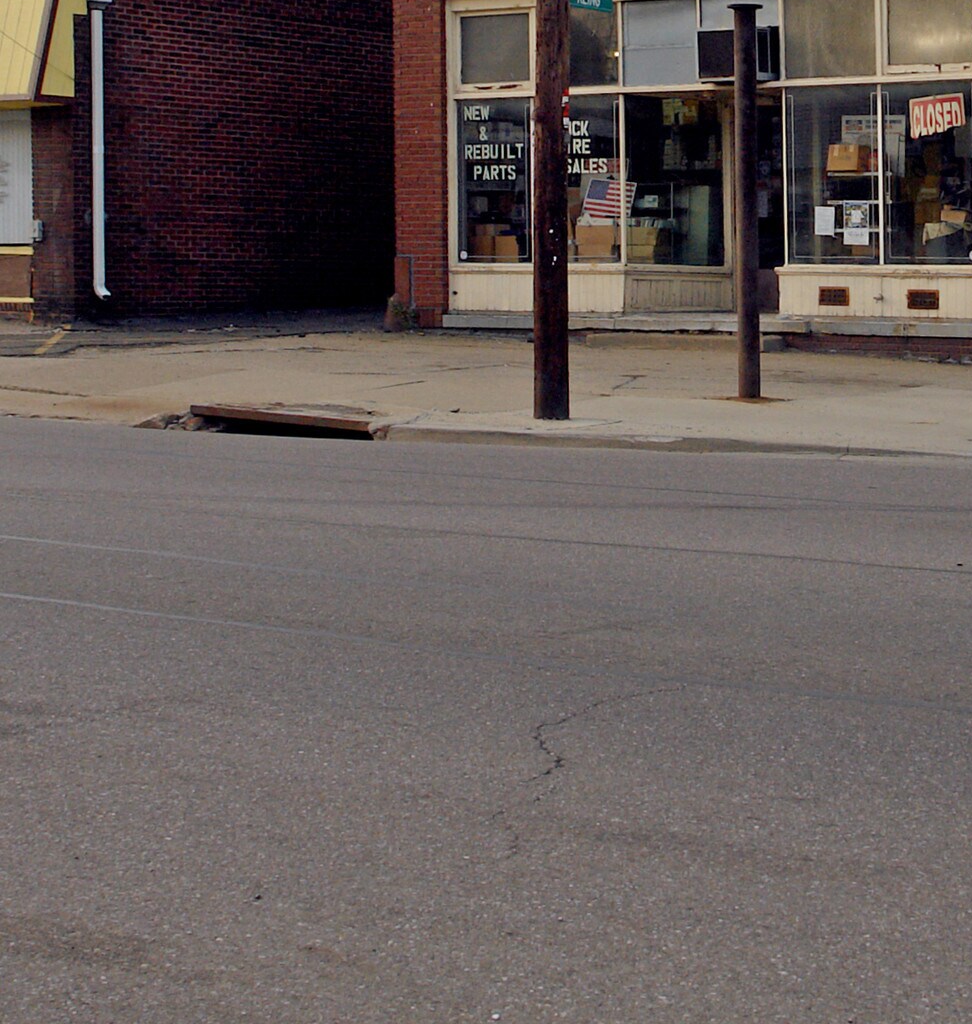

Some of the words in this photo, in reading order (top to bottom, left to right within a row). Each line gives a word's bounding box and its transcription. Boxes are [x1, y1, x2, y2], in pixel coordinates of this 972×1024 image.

[463, 105, 490, 121] NEW
[912, 102, 962, 139] CLOSED
[478, 126, 488, 141] &
[464, 143, 524, 160] REBUILT
[473, 164, 517, 181] PARTS
